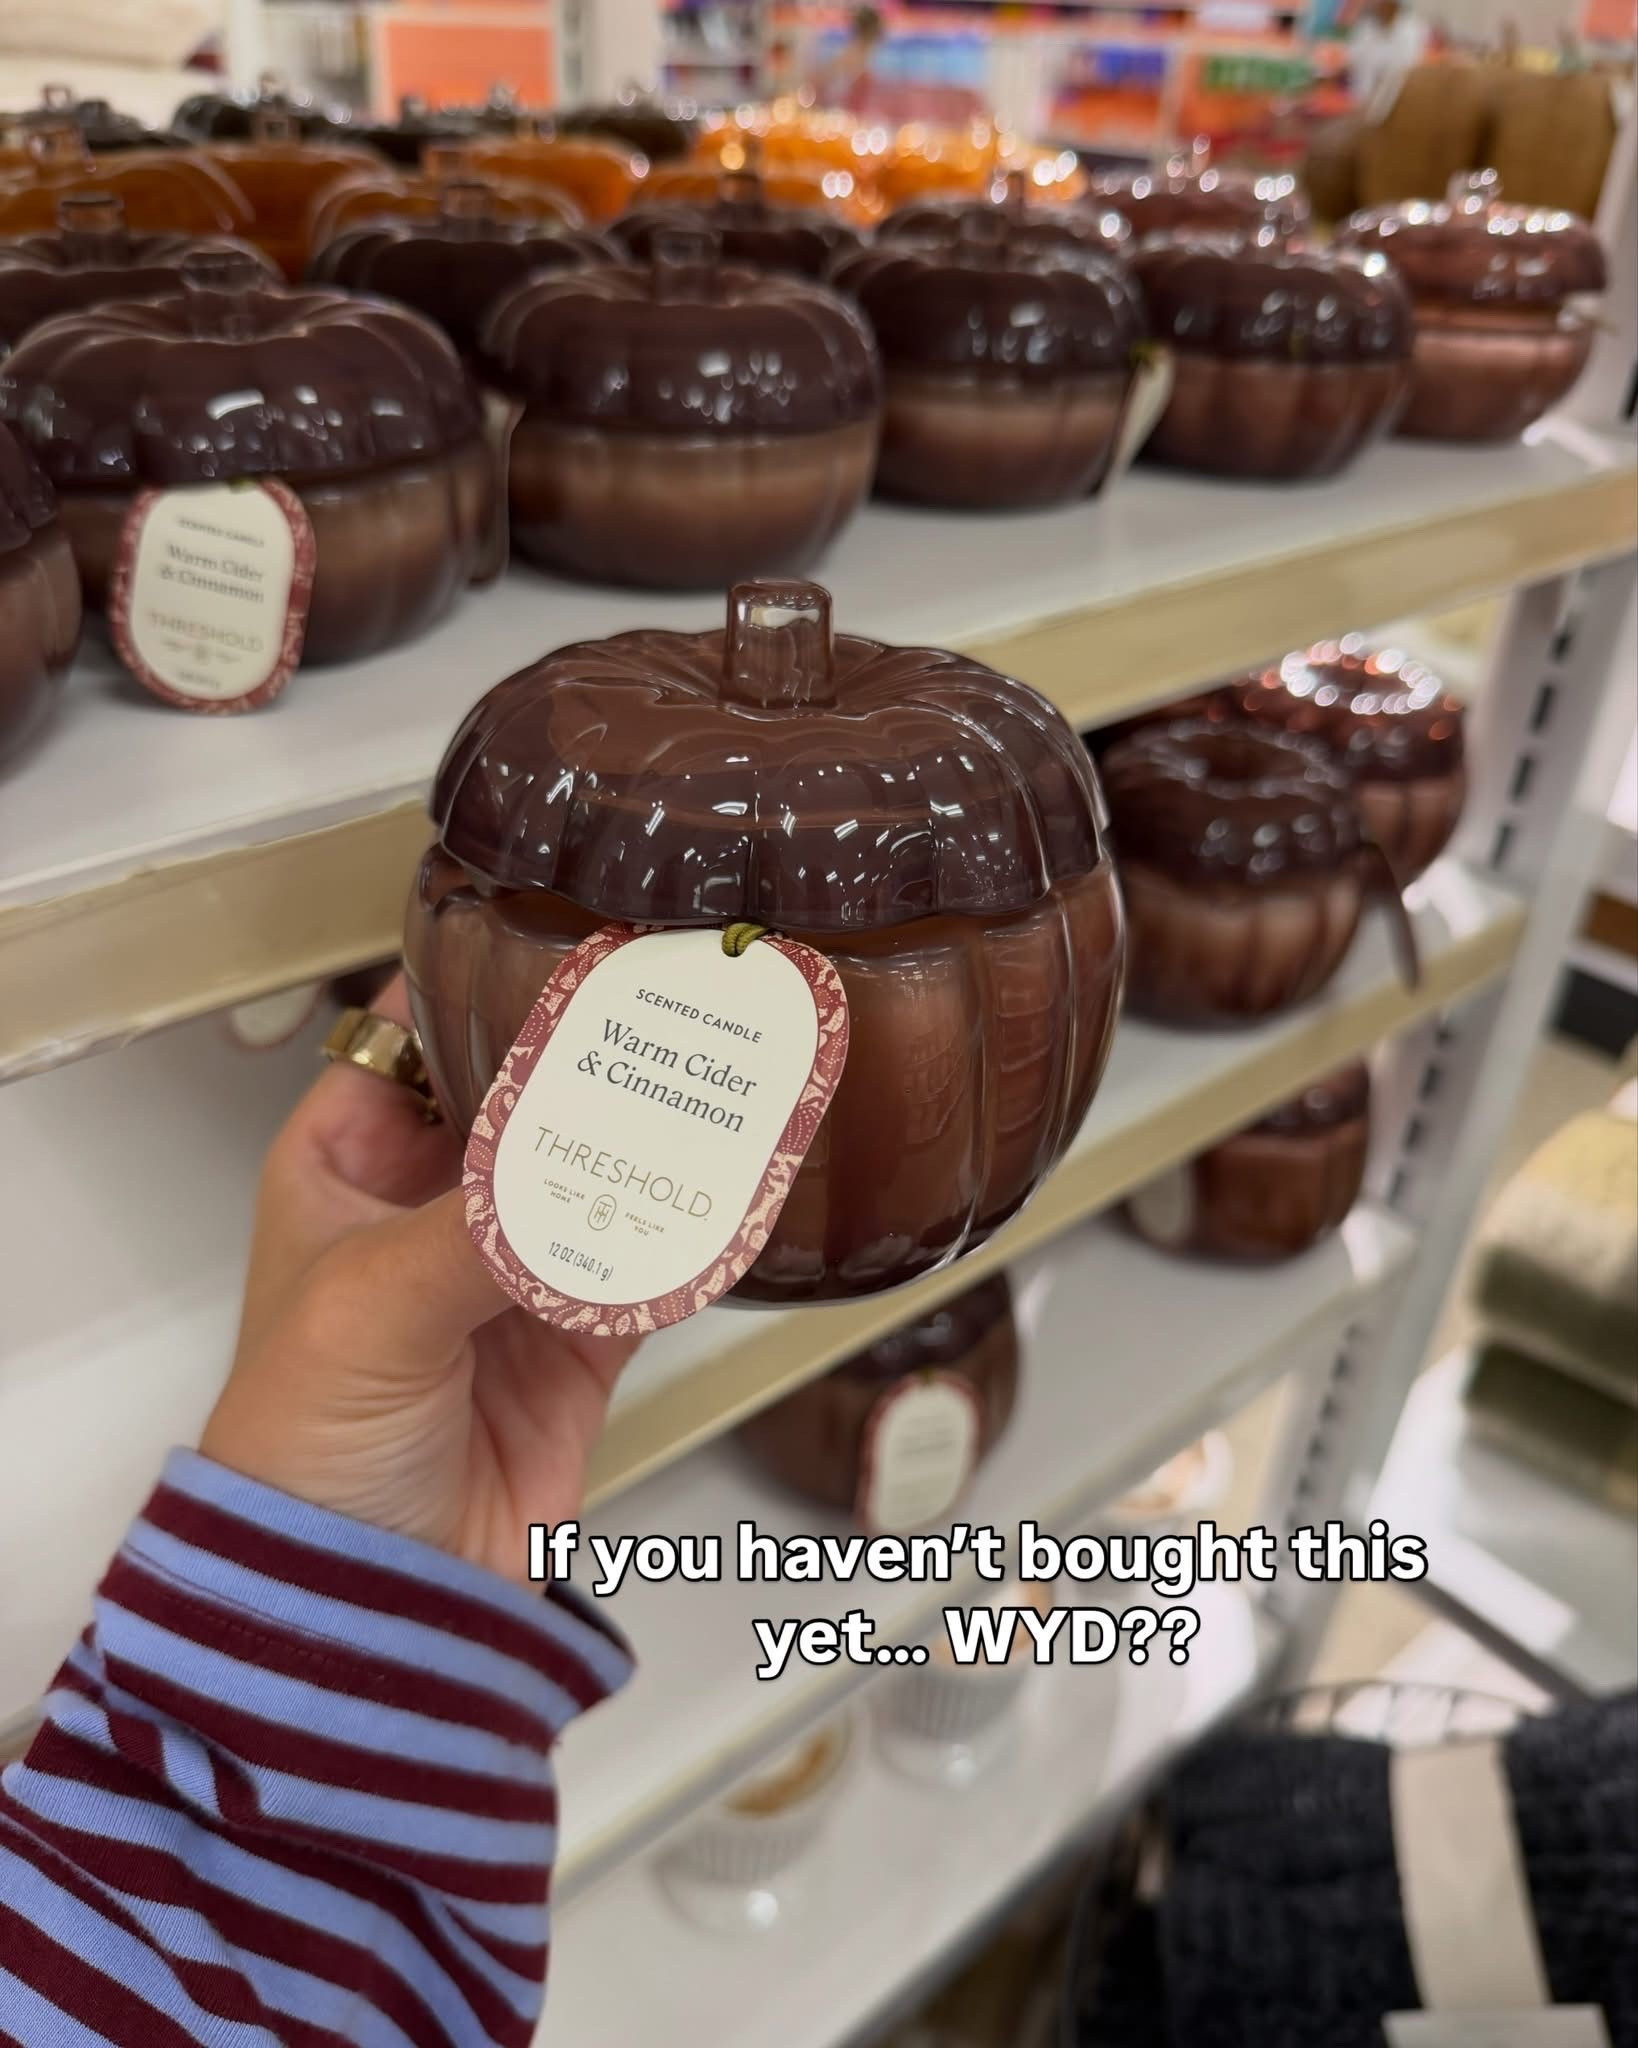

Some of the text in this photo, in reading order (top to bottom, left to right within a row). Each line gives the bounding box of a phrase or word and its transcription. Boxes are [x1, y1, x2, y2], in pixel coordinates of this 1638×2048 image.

[168, 542, 263, 583] Warm Cider
[177, 568, 265, 604] Cinnamon
[635, 988, 763, 1044] SCENTED CANDLE
[602, 1018, 757, 1097] Warm Cider
[576, 1050, 744, 1133] & Cinnamon
[534, 1126, 713, 1219] THRESHOLD
[544, 1178, 586, 1201] LOOKS LIKE
[550, 1190, 571, 1204] HOME
[625, 1212, 665, 1233] FEELS LIKE
[634, 1225, 649, 1236] YOU
[548, 1241, 561, 1258] 12
[572, 1251, 602, 1275] (340.1
[600, 1265, 614, 1281] g)
